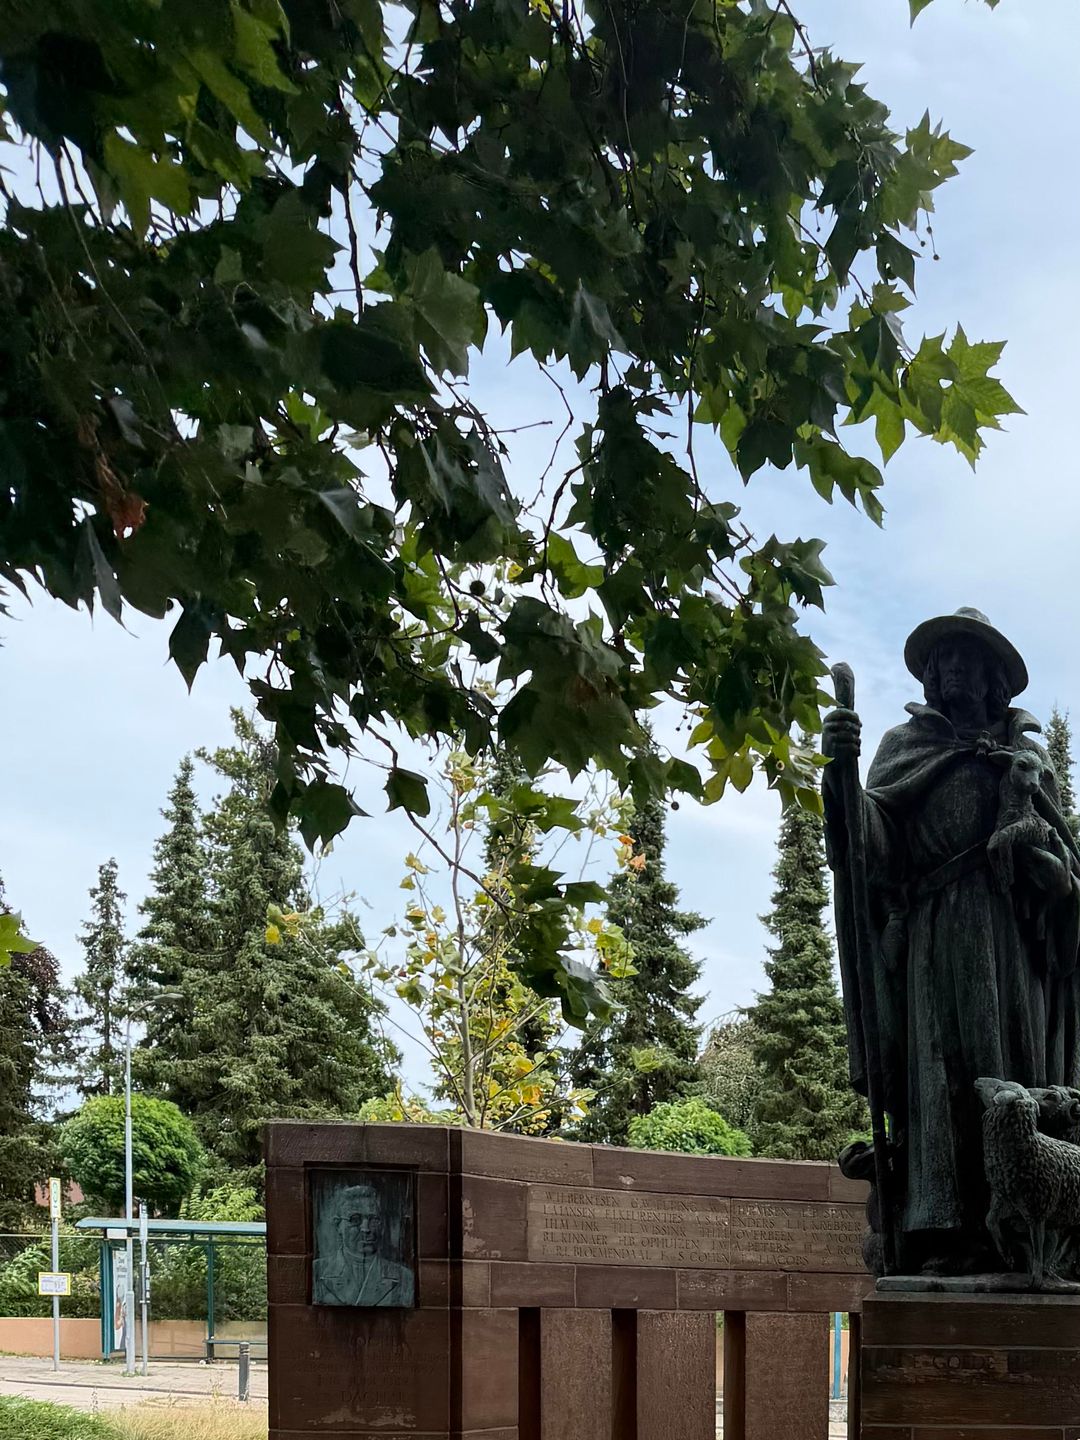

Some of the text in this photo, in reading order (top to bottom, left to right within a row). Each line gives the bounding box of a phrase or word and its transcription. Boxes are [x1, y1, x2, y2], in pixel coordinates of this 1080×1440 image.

[735, 1230, 795, 1241] OVERBEEK
[747, 1242, 790, 1253] PETERS
[573, 1246, 652, 1261] BLOEMENDAAL
[690, 1251, 730, 1264] COHEN
